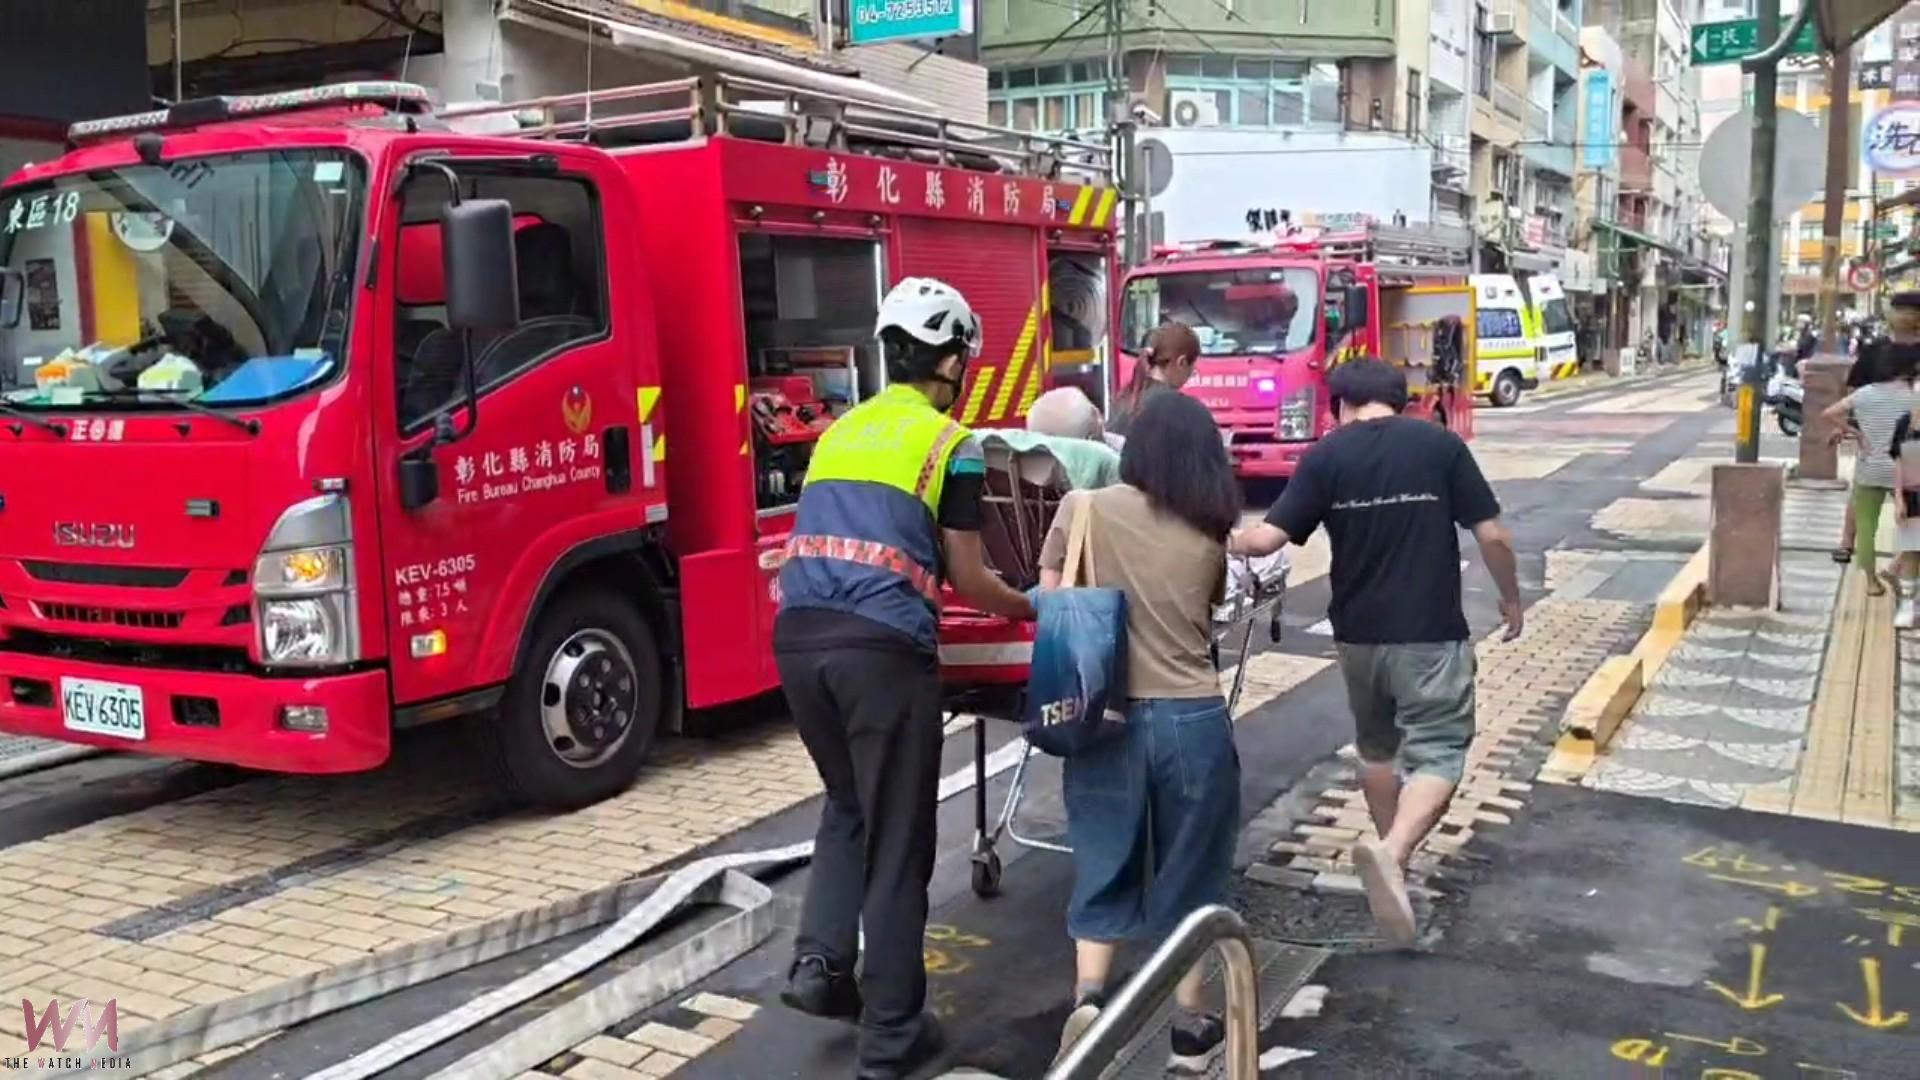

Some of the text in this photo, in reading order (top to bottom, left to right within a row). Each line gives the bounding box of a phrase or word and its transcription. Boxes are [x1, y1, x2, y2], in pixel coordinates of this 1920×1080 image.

[826, 156, 1056, 220] 彰化縣消防局
[454, 433, 600, 485] 彰化縣消防局
[457, 465, 600, 504] Fire Bureau Changhua County
[54, 520, 135, 549] ISUZU
[395, 553, 476, 587] KEV-6305
